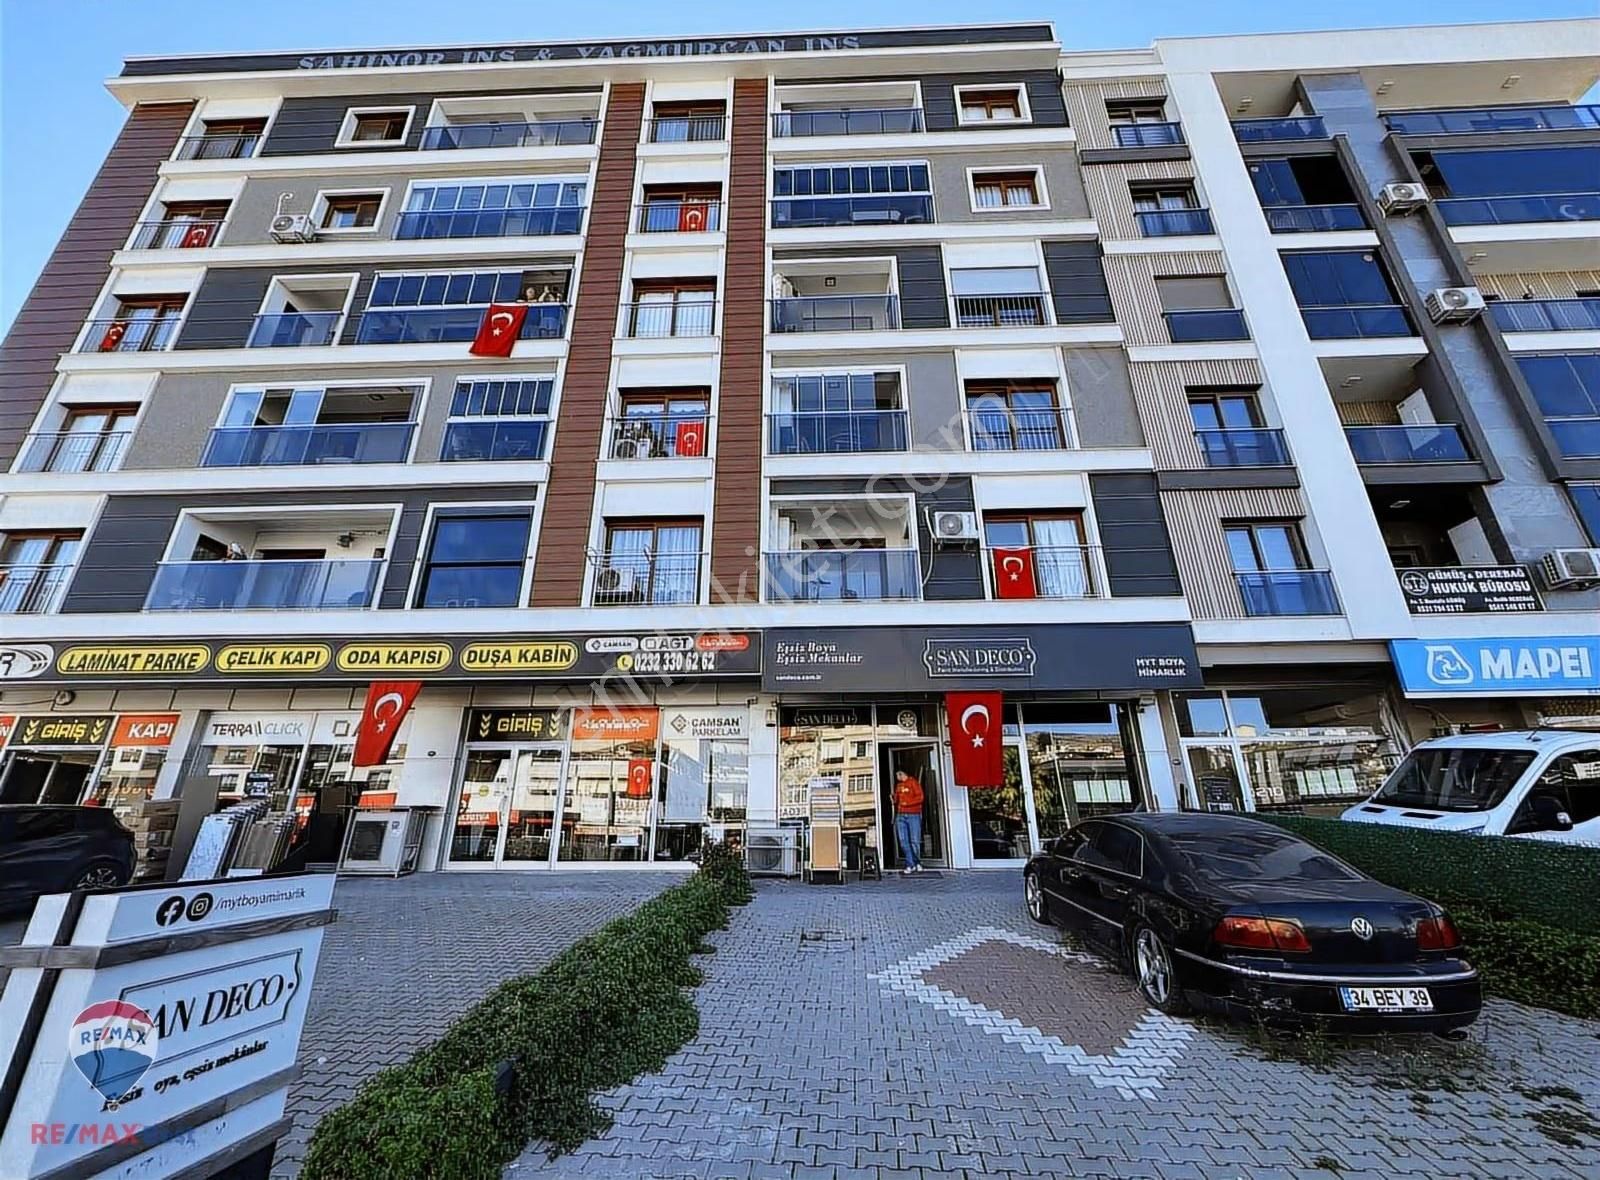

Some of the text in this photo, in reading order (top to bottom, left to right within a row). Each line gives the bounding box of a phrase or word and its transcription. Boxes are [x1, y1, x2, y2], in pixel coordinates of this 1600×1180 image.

[461, 49, 515, 64] INS
[804, 35, 861, 51] INS
[1431, 580, 1531, 594] HUKUK BÜROSU
[659, 637, 689, 650] AGT
[65, 649, 200, 671] LAMİNAT PARKE
[225, 645, 321, 669] ÇELİK KAPI
[347, 649, 443, 666] ODA KAPISI
[466, 643, 571, 668] DUŞA KABİN
[634, 651, 715, 671] 0232 330 62 62
[935, 648, 1022, 667] SAN DECO
[1479, 647, 1592, 680] MAPEI
[40, 719, 88, 743] GİRİŞ
[128, 722, 173, 739] KAPI
[212, 722, 304, 737] TERRA CLICK
[497, 713, 543, 737] GİRİŞ
[691, 717, 740, 727] CAMSAN
[691, 727, 741, 737] PARKELAM
[200, 973, 285, 1027] DECO
[1350, 989, 1429, 1006] 34 BEY 39
